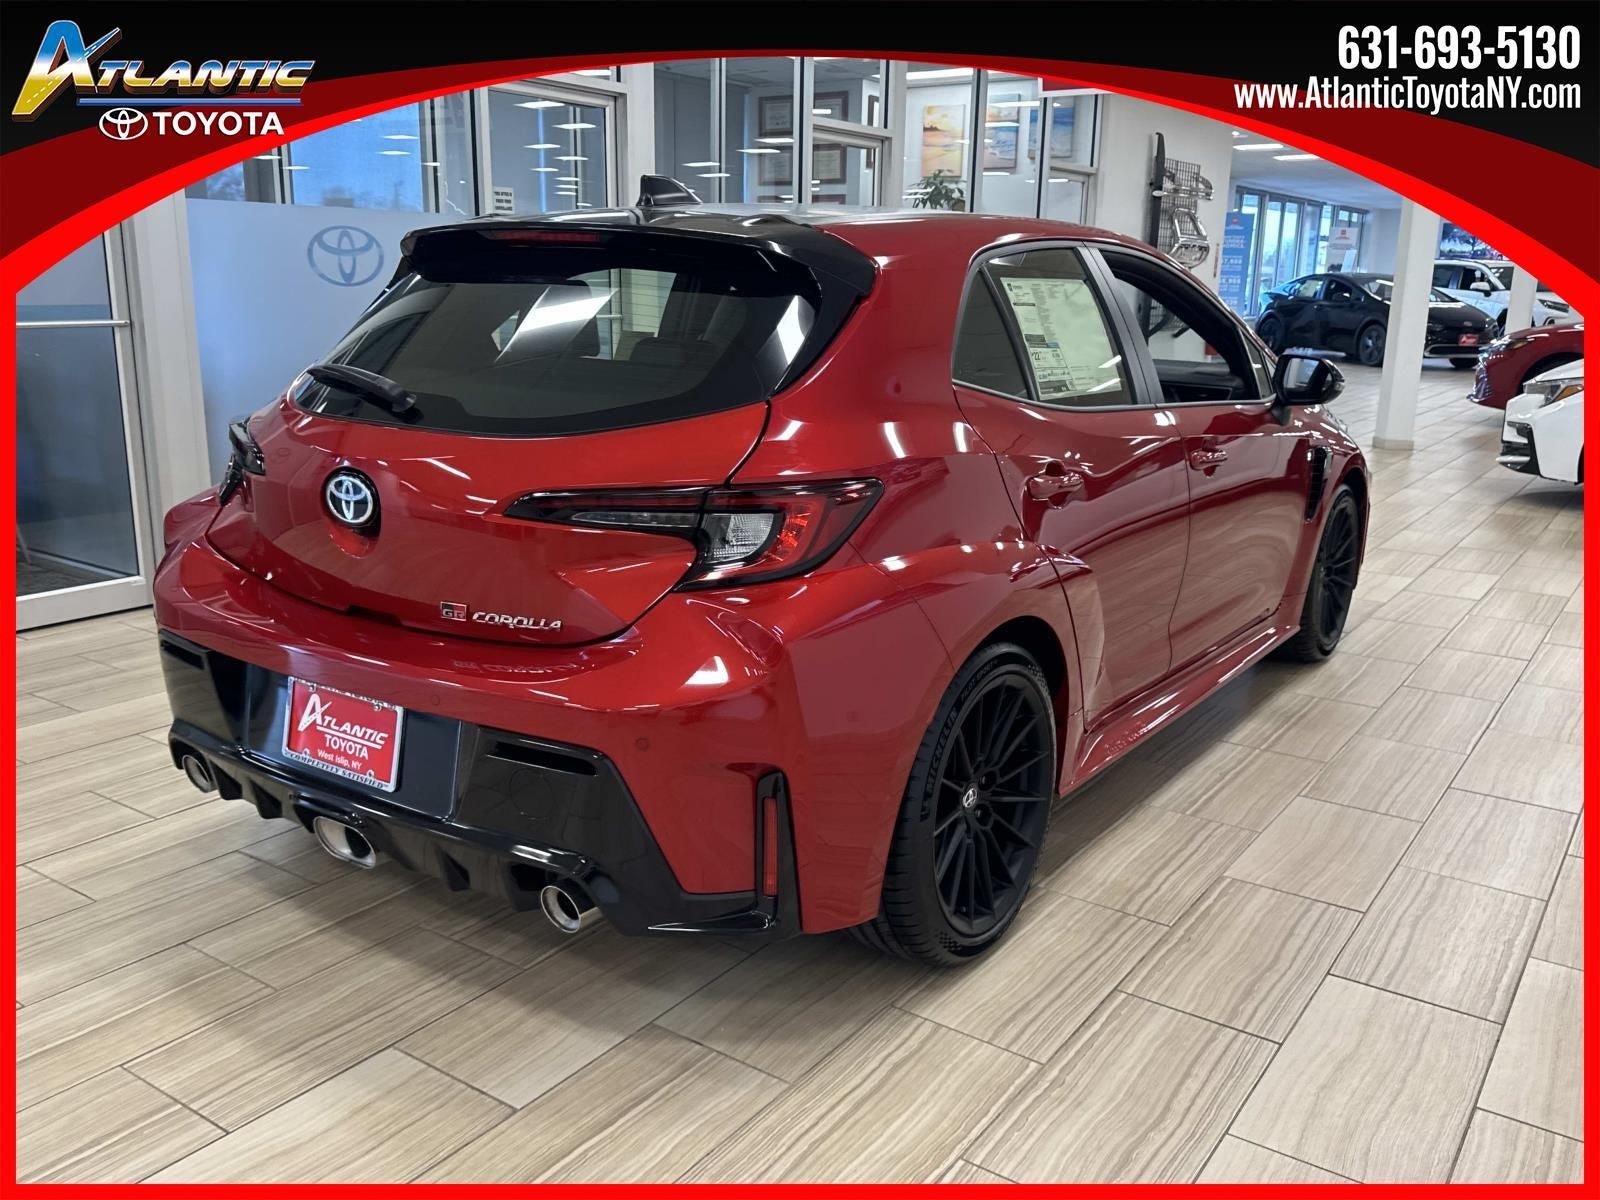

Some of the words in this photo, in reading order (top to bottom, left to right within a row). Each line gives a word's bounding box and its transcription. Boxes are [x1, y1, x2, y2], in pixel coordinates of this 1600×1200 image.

[472, 611, 561, 631] COROLLA
[298, 693, 388, 745] ATLANTIC
[324, 734, 368, 760] TOYOTA
[926, 707, 957, 796] MICHELIN
[290, 753, 340, 773] COMPLETELY
[317, 749, 334, 761] West
[351, 761, 362, 769] NY
